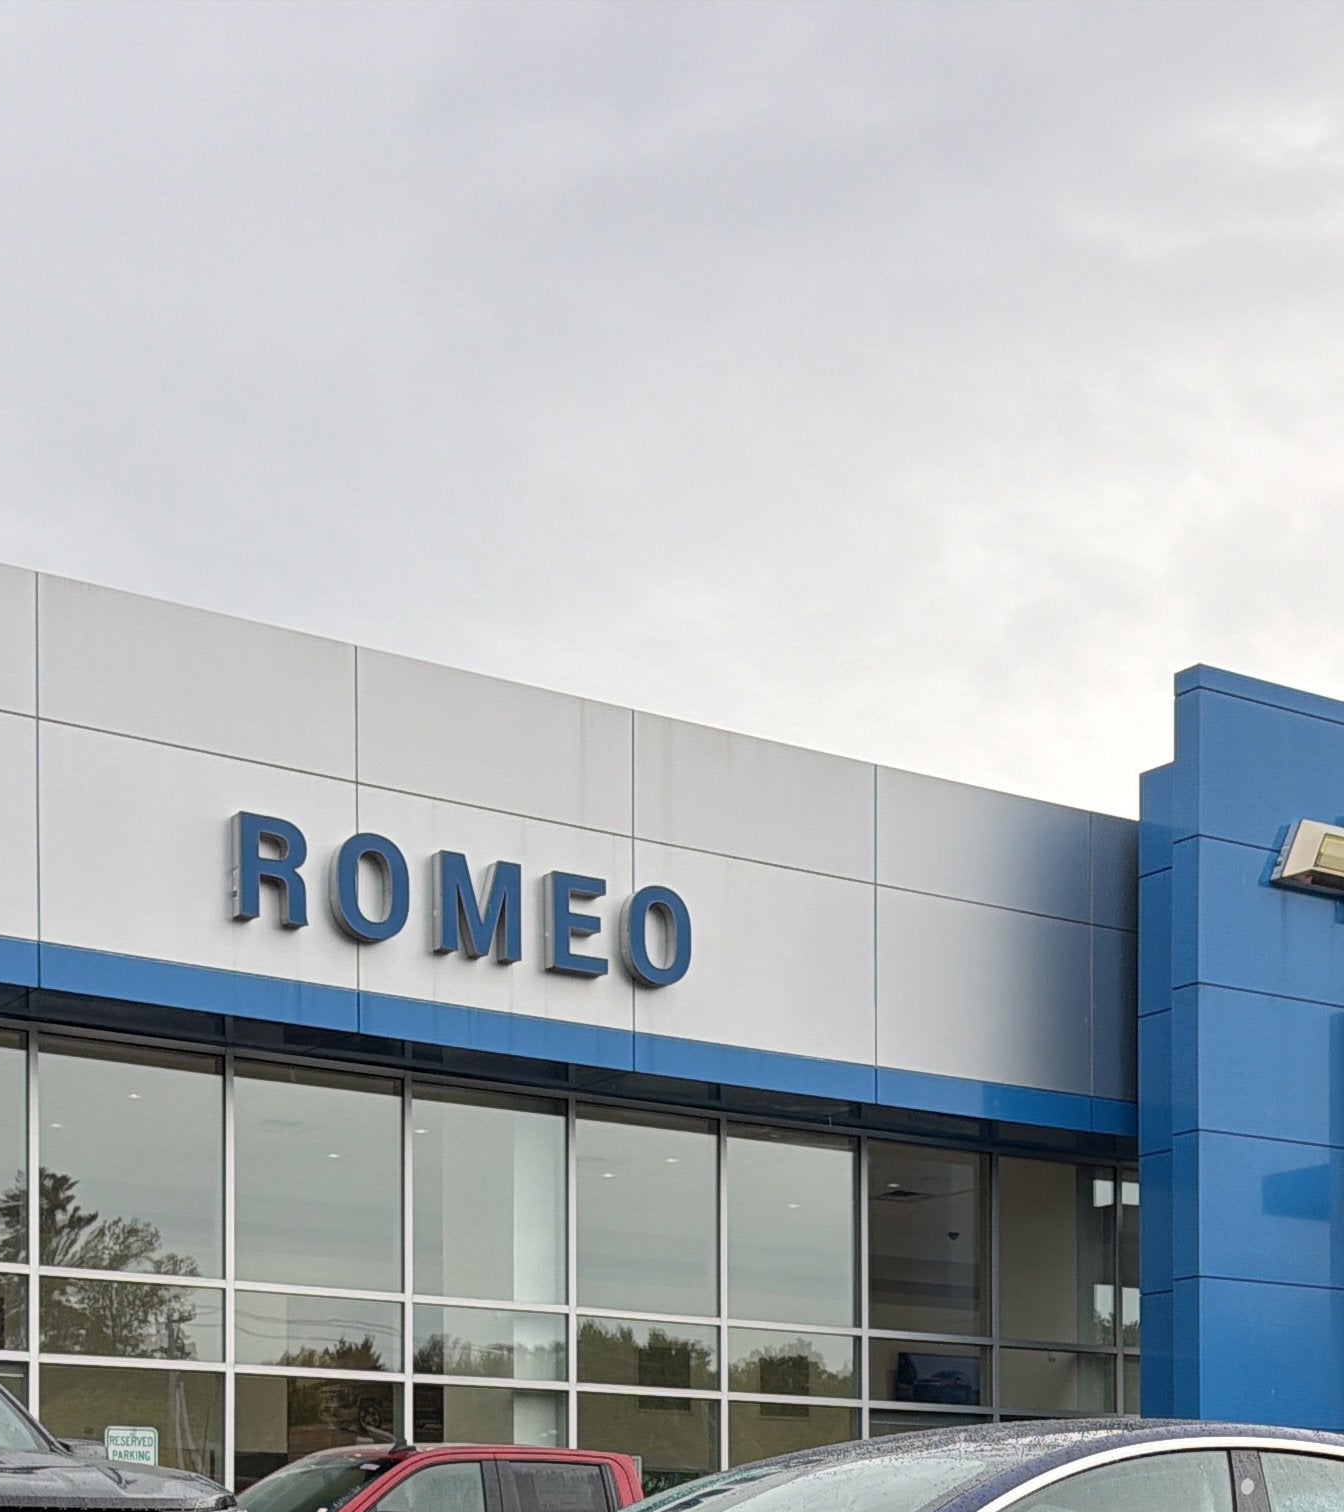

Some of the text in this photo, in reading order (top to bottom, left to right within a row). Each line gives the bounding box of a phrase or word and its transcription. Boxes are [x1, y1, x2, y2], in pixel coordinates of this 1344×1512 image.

[230, 810, 692, 988] ROMEO
[109, 1435, 153, 1448] RESERVED
[112, 1450, 151, 1461] PARKING
